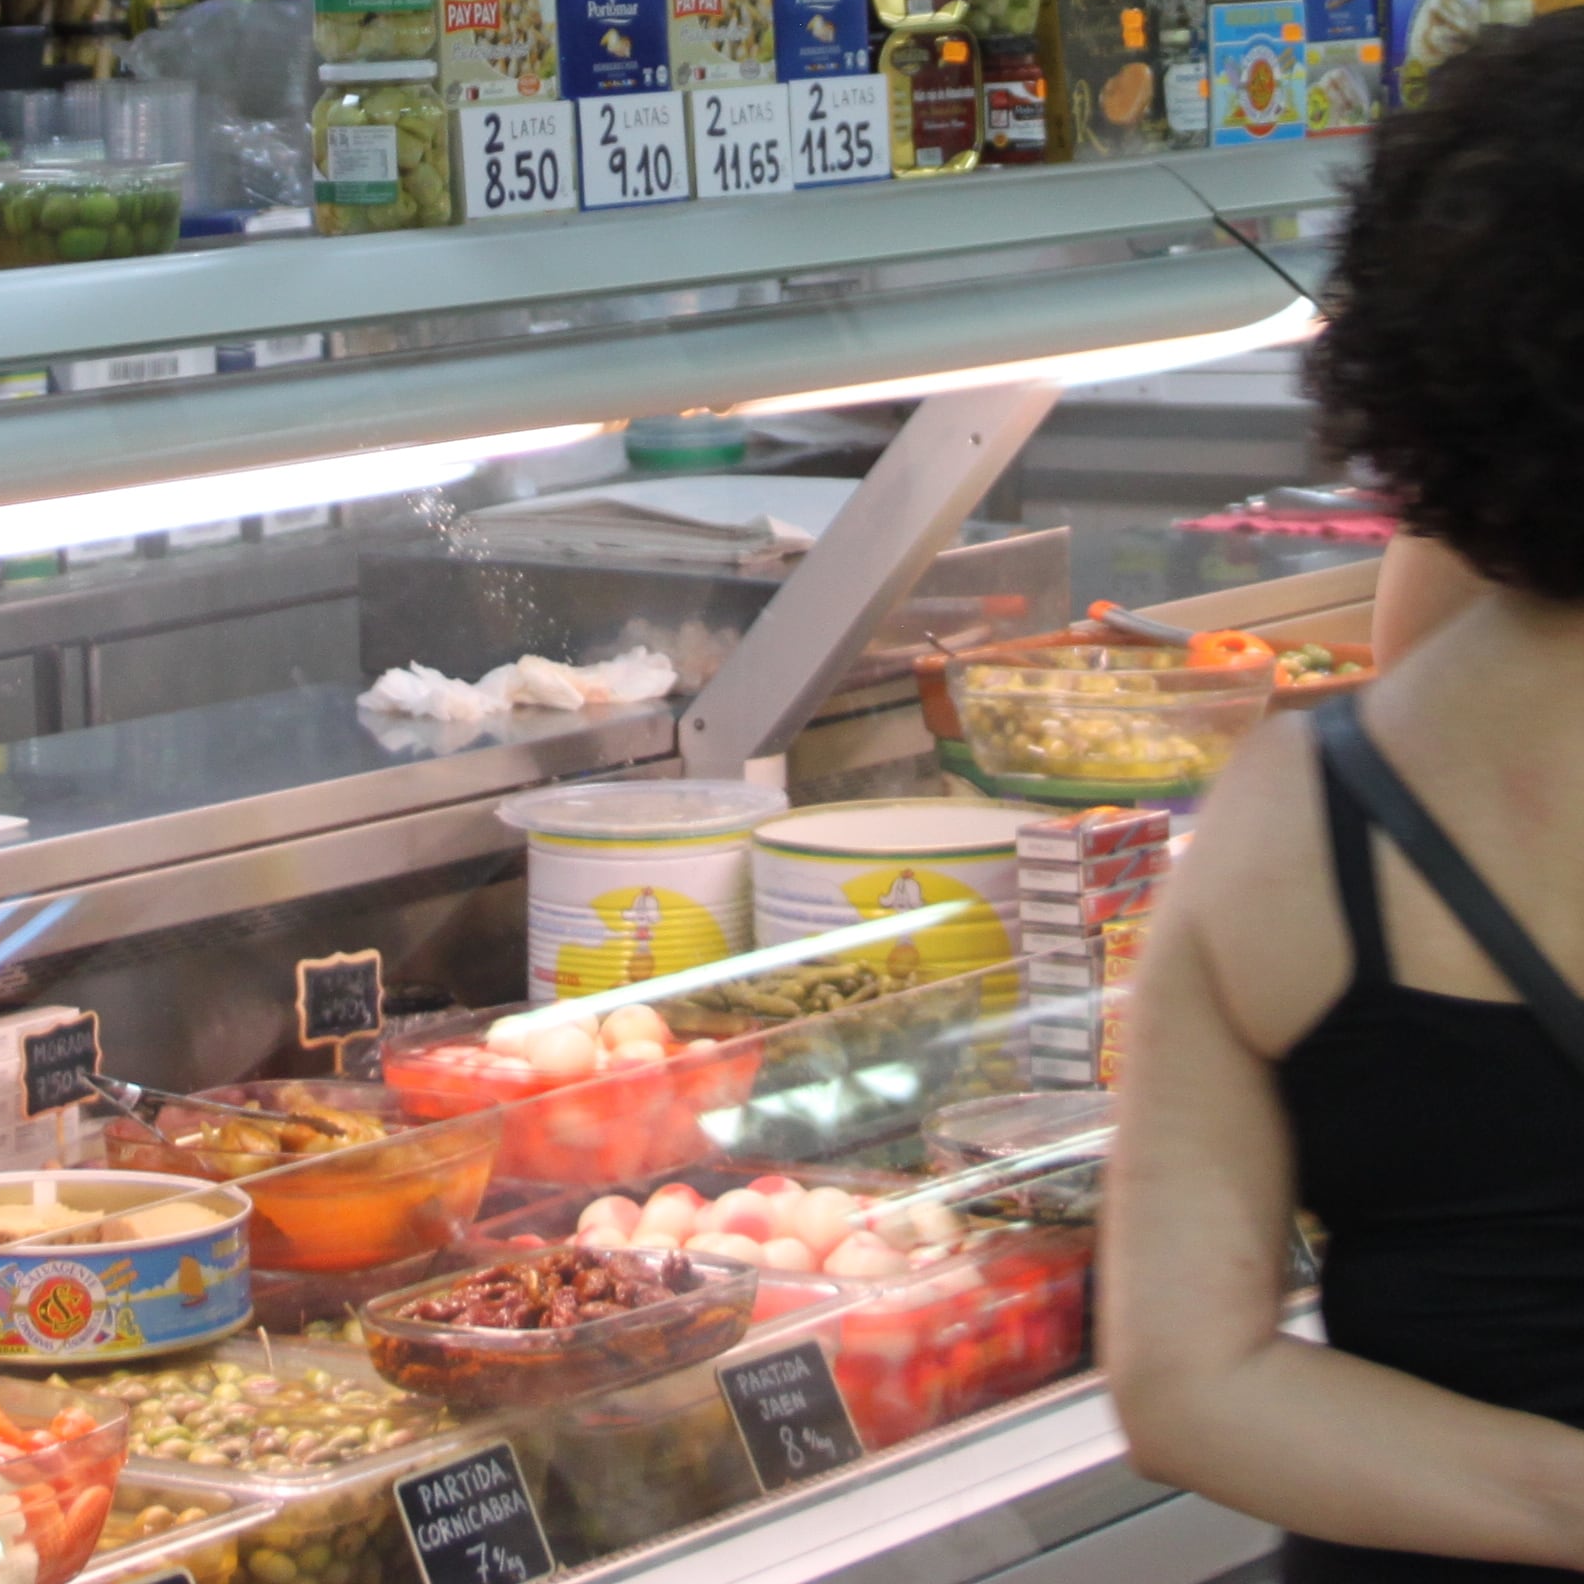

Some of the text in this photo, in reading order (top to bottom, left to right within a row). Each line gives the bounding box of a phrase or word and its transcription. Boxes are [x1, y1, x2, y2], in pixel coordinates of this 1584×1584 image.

[446, 2, 499, 28] PAY PAY
[587, 1, 639, 18] Portomar
[705, 95, 775, 137] 2 LATAS
[808, 82, 876, 121] 2 LATAS
[484, 112, 557, 154] 2 LATAS
[599, 103, 671, 146] 2 LATAS
[759, 1389, 808, 1422] JAEN
[779, 1424, 805, 1470] 8
[465, 1540, 490, 1584] 7
